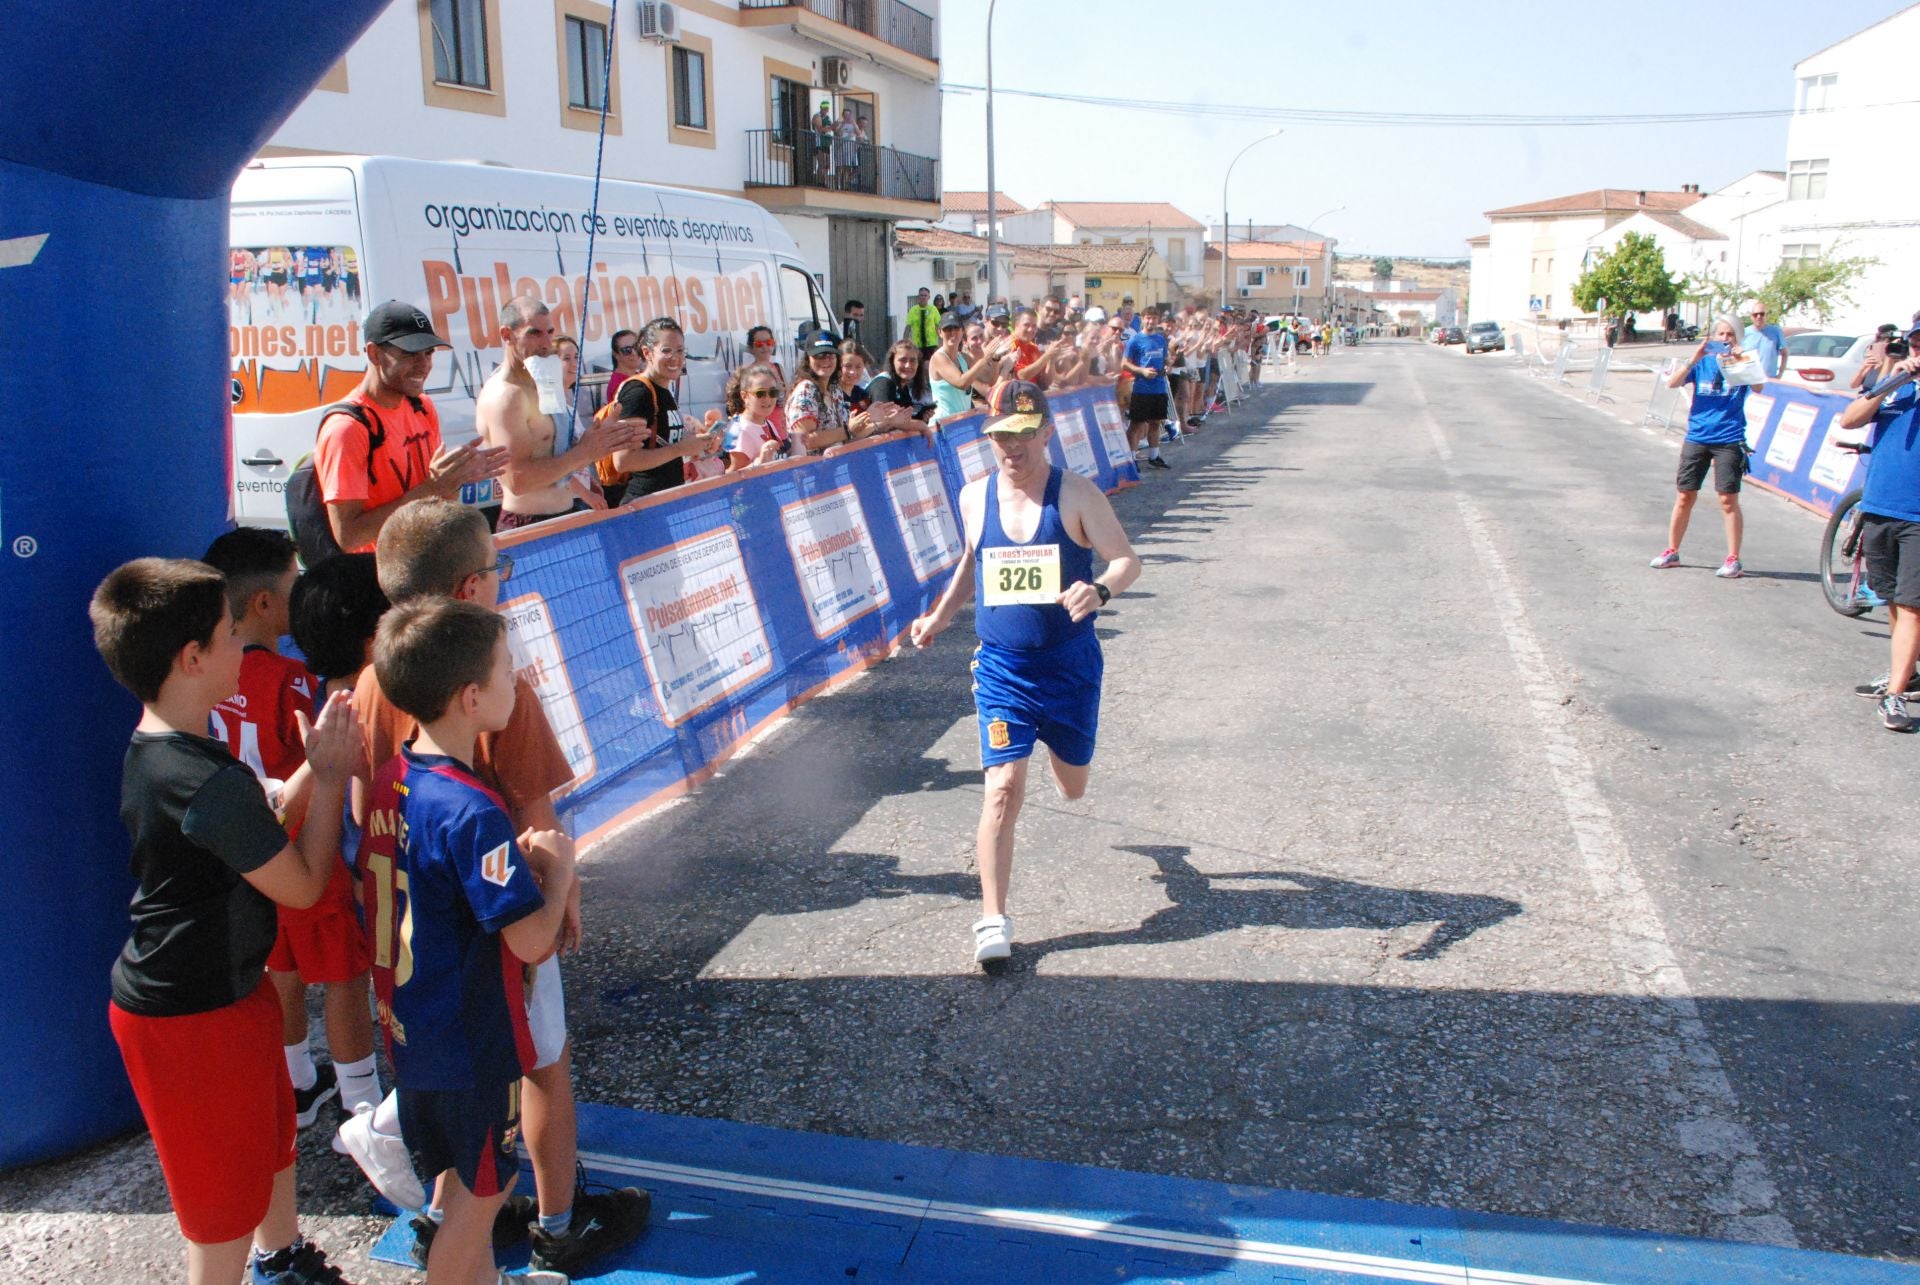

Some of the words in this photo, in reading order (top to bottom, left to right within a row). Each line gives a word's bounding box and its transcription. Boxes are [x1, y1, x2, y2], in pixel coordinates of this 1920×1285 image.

[424, 202, 576, 237] organizacion
[581, 208, 607, 235] de
[614, 213, 679, 238] eventos
[682, 217, 754, 245] deportivos
[1022, 548, 1053, 558] POPULAR
[999, 566, 1042, 592] 326
[645, 573, 740, 633] Pulsaciones.net
